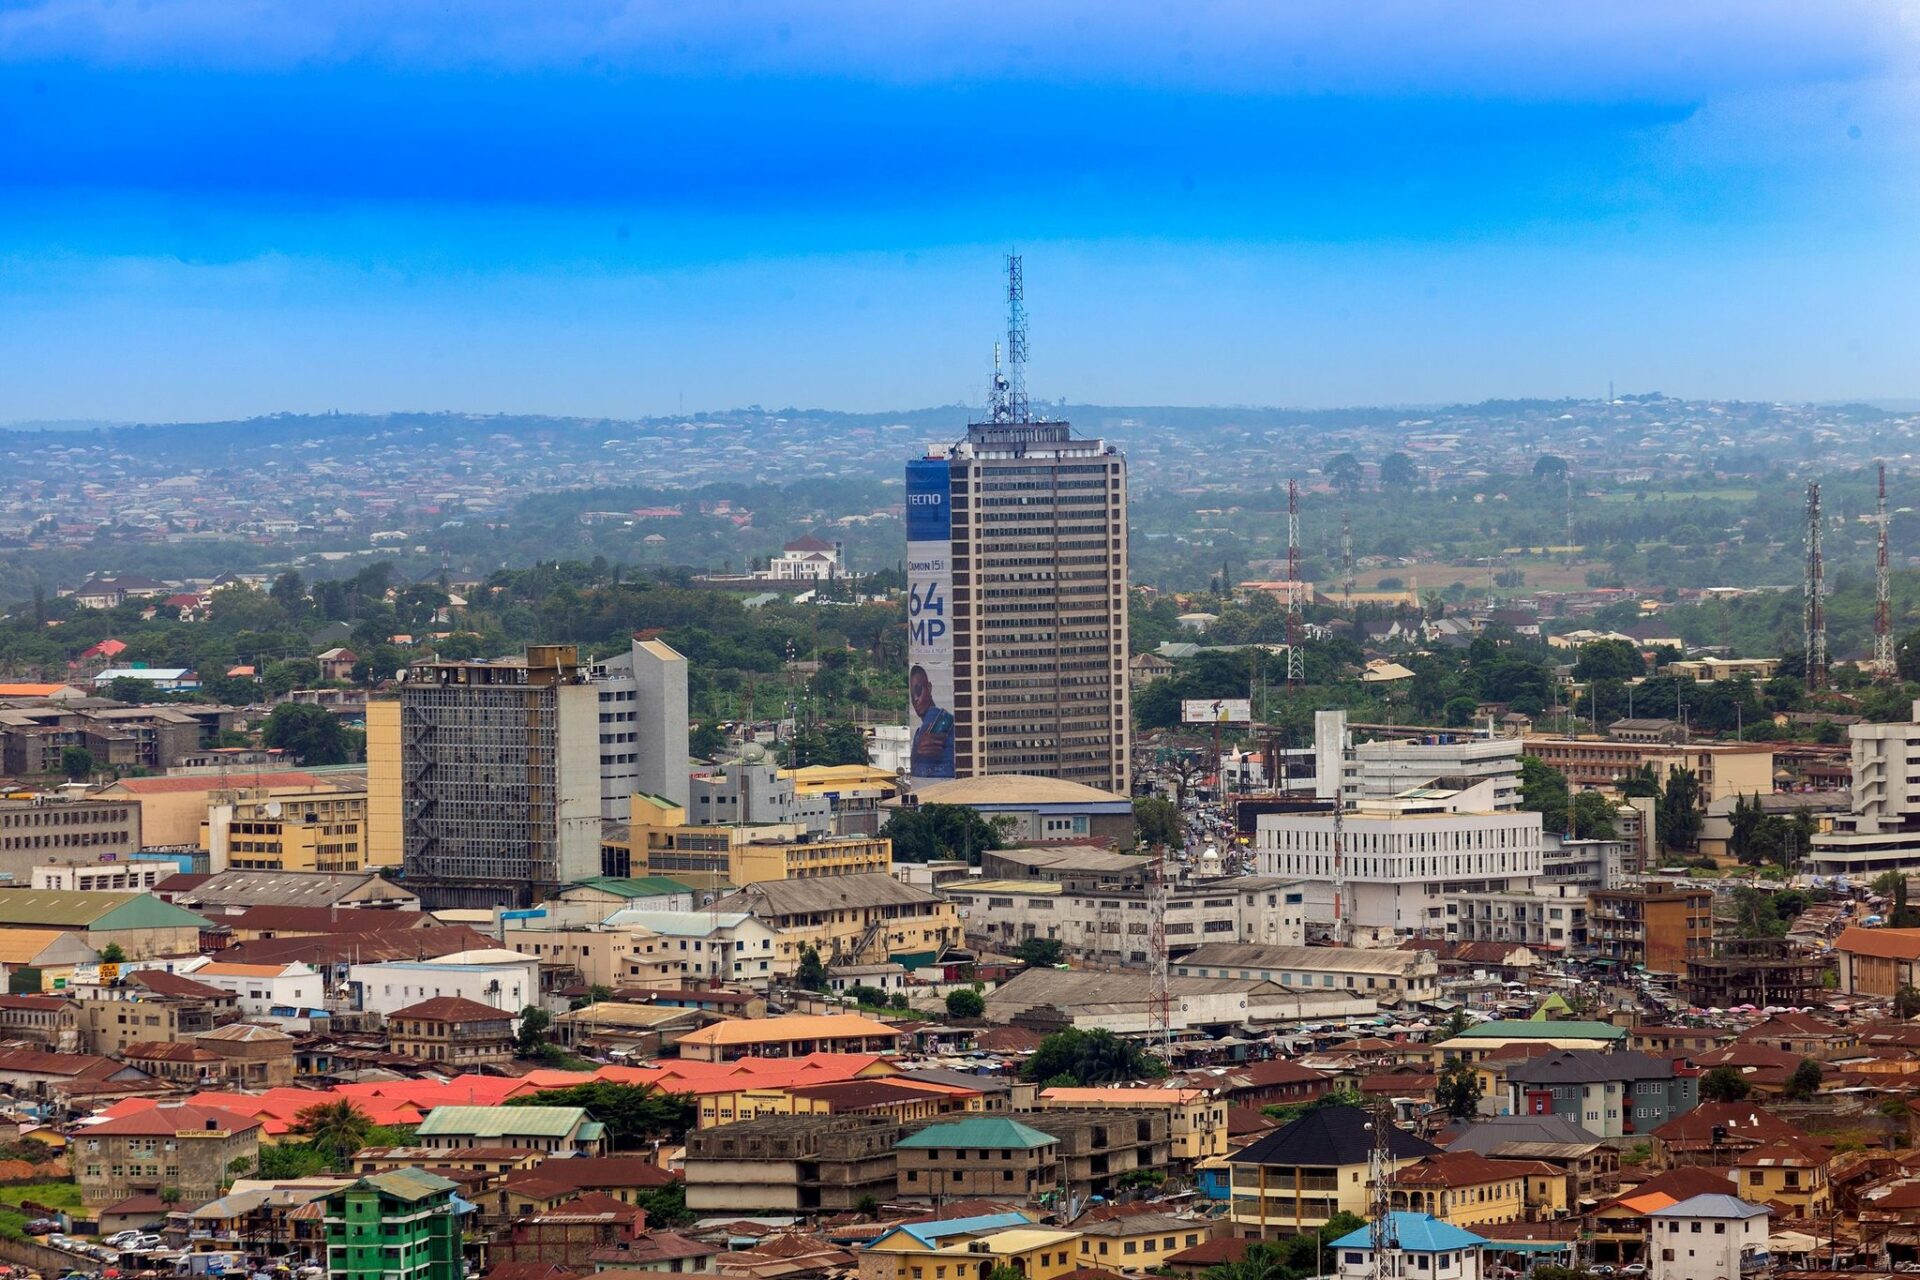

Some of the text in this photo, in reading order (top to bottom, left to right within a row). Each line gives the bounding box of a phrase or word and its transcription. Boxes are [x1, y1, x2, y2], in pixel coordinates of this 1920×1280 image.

[908, 494, 941, 505] TECNO
[910, 582, 943, 616] 64
[910, 619, 946, 646] MP
